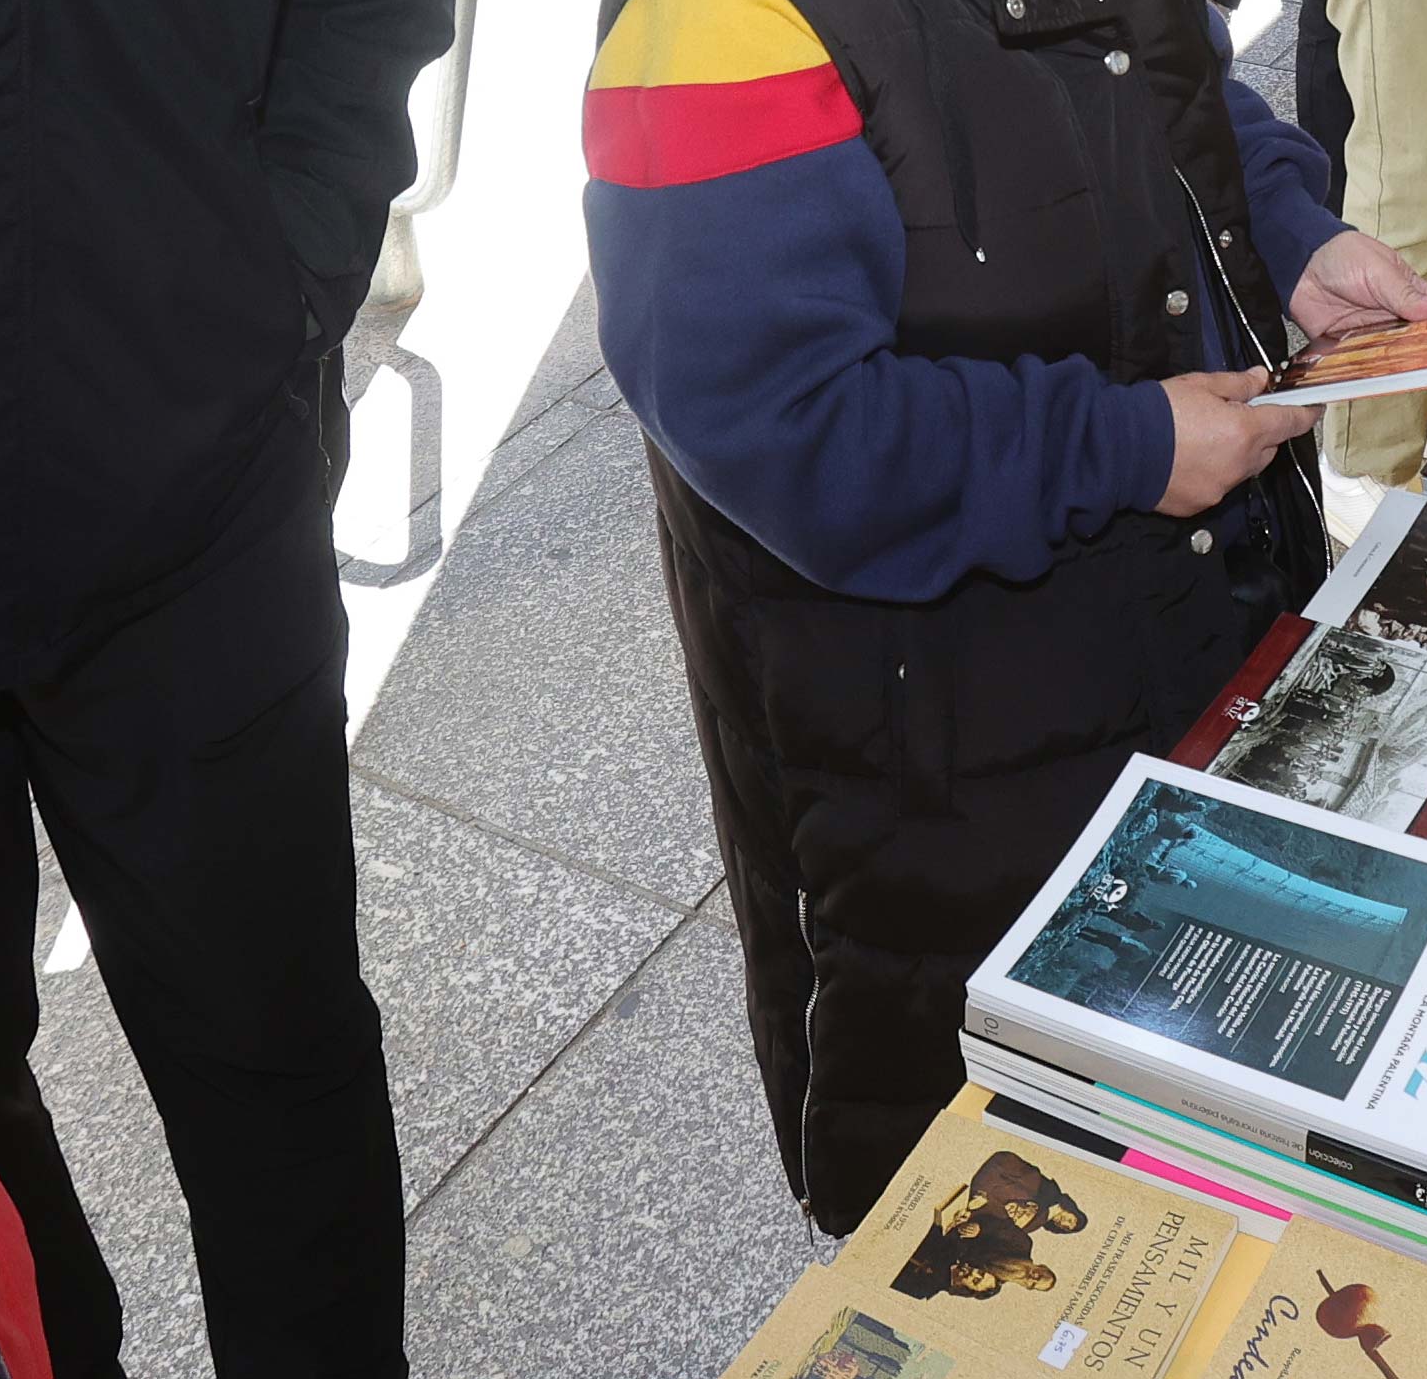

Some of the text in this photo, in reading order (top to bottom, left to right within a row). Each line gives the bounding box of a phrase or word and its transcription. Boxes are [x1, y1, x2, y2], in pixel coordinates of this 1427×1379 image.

[1393, 1007, 1427, 1058] MONTAÑA
[1364, 1056, 1401, 1112] PALENTINA
[1073, 1230, 1134, 1328] MIL FRASES ESCOGIDAS
[1077, 1215, 1126, 1291] DE CIEN HOMBRES
[1083, 1208, 1185, 1371] PENSAMIENTOS
[1122, 1234, 1209, 1370] MIL Y UN
